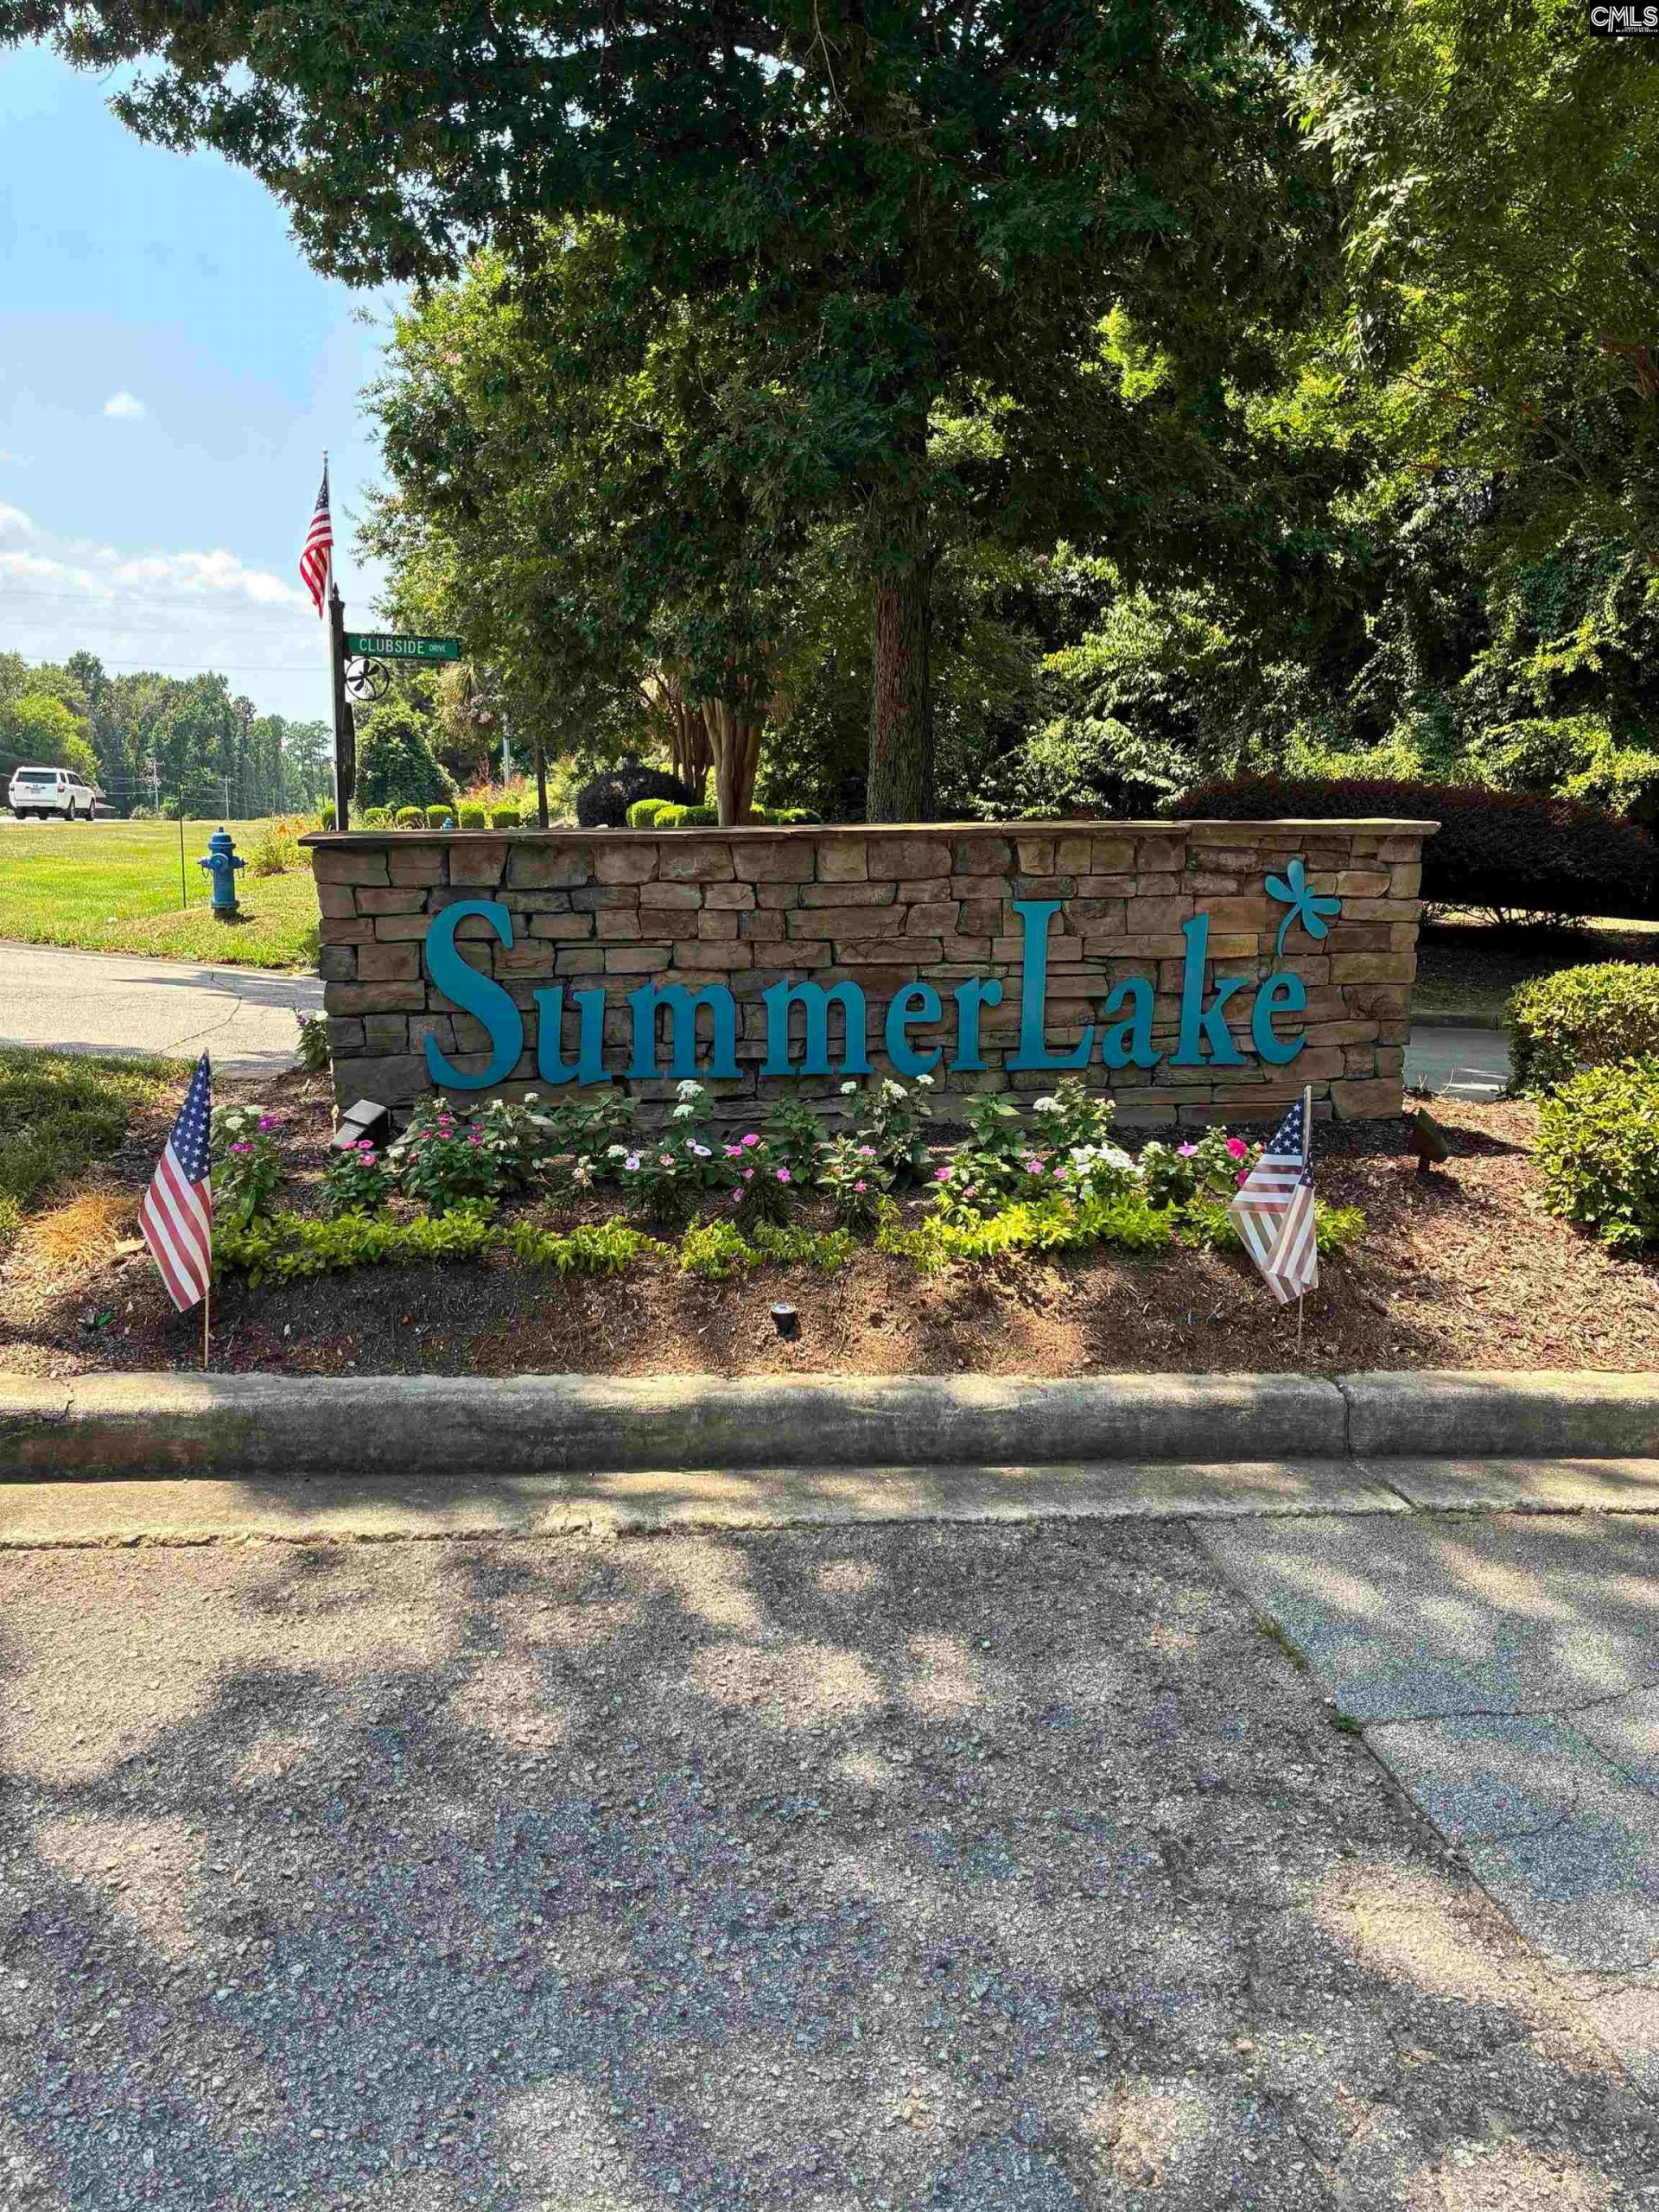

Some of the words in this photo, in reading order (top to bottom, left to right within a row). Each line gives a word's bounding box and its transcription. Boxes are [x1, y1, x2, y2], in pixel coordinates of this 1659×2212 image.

[359, 638, 425, 654] CLUBSIDE
[429, 644, 447, 653] DRIVE
[424, 899, 1307, 1090] SummerLake
